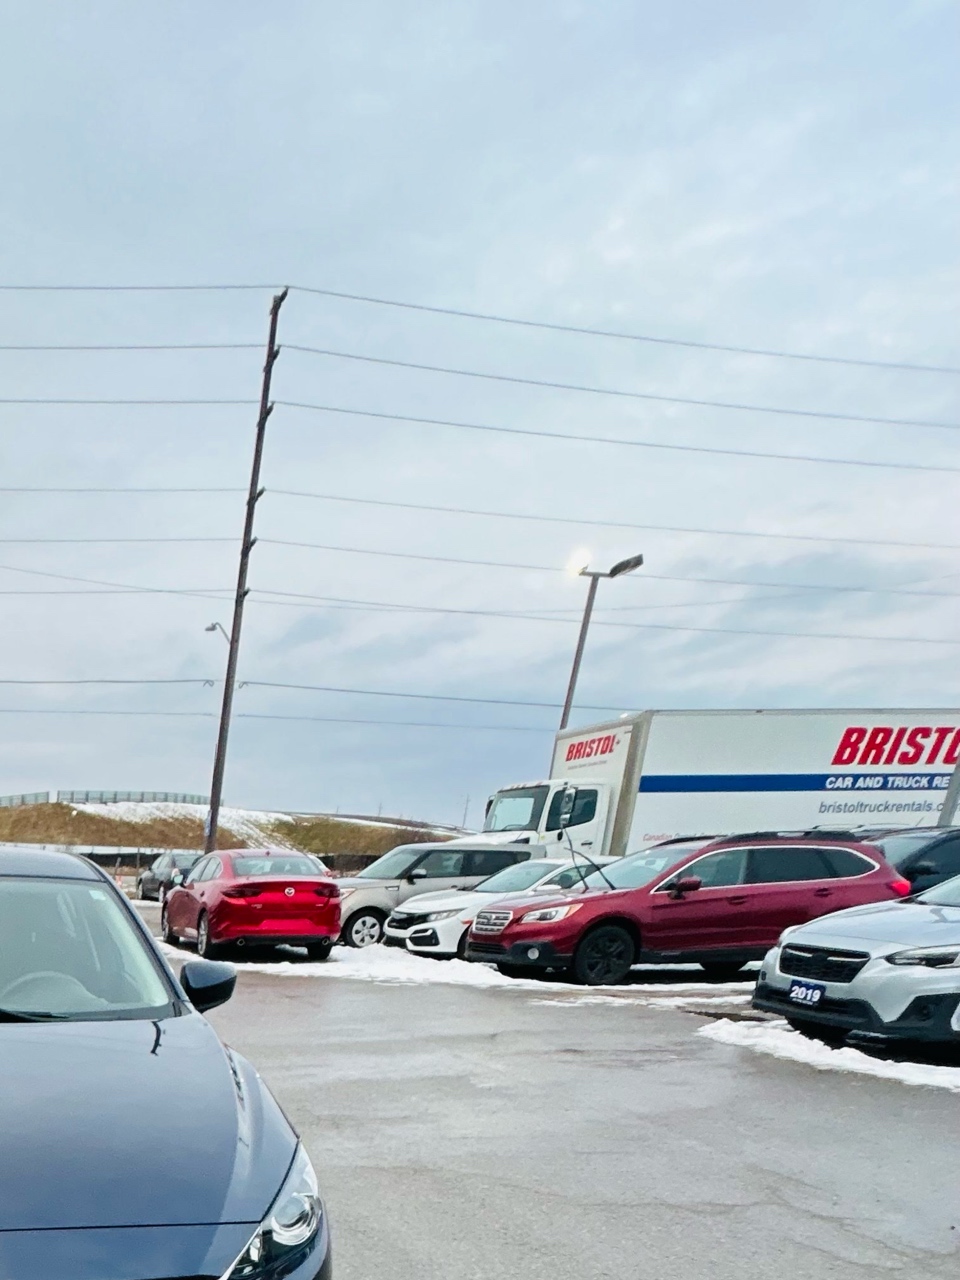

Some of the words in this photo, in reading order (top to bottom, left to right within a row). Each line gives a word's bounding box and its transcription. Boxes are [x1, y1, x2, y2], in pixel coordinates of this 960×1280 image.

[565, 734, 617, 762] BRISTOL
[825, 776, 853, 789] CAR
[855, 776, 884, 788] AND
[887, 776, 930, 788] TRUCK
[932, 776, 951, 788] RE
[818, 800, 960, 814] bristoltruckrentals.c
[790, 985, 821, 1002] 2019
